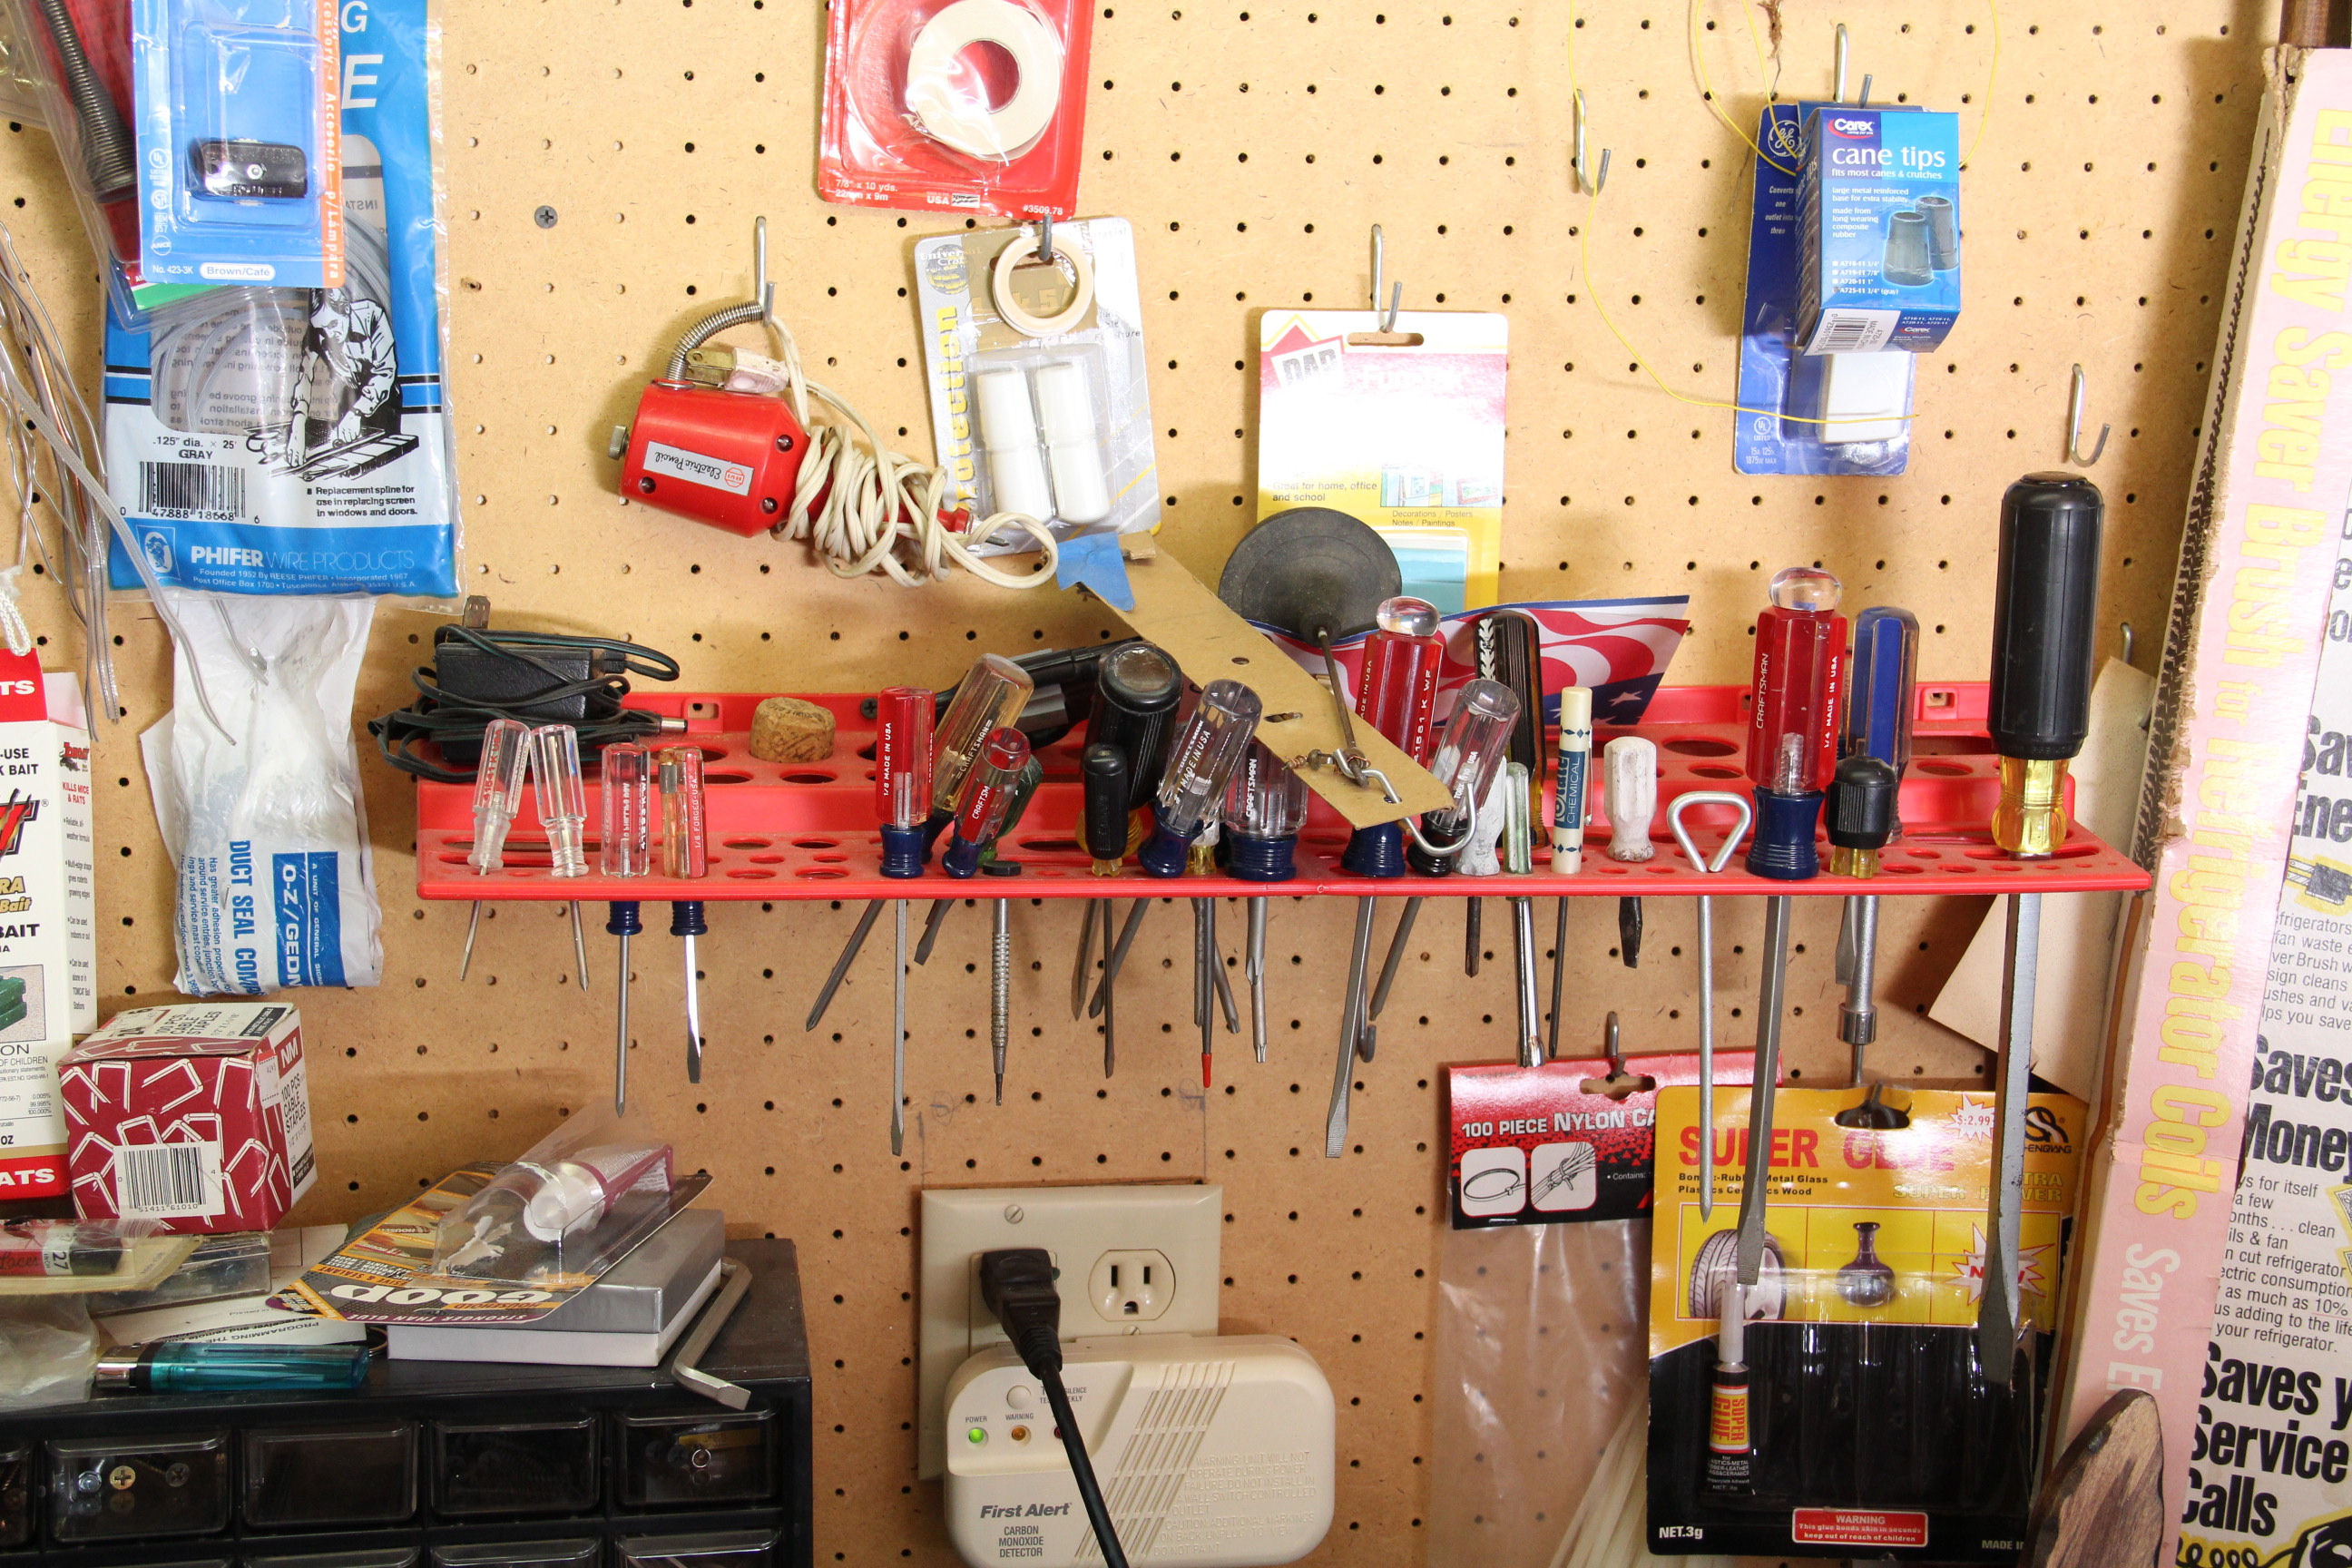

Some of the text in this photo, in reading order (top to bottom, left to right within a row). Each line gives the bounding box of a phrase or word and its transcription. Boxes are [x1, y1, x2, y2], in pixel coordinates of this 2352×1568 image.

[324, 92, 336, 172] Accesorio
[1834, 118, 1873, 132] Carex
[1832, 146, 1946, 171] cane tips
[1831, 168, 1846, 177] fits
[1871, 170, 1896, 178] canes
[1906, 171, 1942, 180] crutches
[878, 183, 898, 193] yds.
[1769, 185, 1794, 195] Converts
[1832, 187, 1849, 195] large
[1873, 187, 1909, 196] reinforced
[926, 195, 950, 206] USA
[1023, 205, 1063, 216] #3509.78
[1832, 215, 1879, 225] long wearing
[1832, 224, 1869, 232] composite
[207, 266, 270, 277] Brown/Café
[2253, 325, 2352, 494] Saver
[183, 437, 203, 447] dia.
[178, 449, 213, 460] GRAY
[654, 452, 722, 481] Electric Pencil
[316, 485, 401, 497] Replacement spline
[1317, 481, 1377, 493] home, office
[344, 497, 416, 507] replacing screen
[1272, 493, 1326, 502] and school
[327, 507, 418, 516] windows and doors.
[1392, 510, 1475, 518] Decorations Posters
[1392, 518, 1455, 529] Notes Paintings
[191, 545, 416, 572] PHIFER WIRE PRODUCTS
[193, 576, 238, 586] Post Office
[200, 568, 236, 578] Founded
[2223, 503, 2328, 670] Brush
[1365, 659, 1373, 683] USA
[1756, 652, 1769, 730] CRAFTSMAN
[1826, 655, 1838, 727] MADE USA
[959, 725, 991, 773] CRAFTSMAN
[1180, 729, 1211, 789] MADE USA
[9, 764, 39, 776] BAIT
[62, 781, 77, 793] KILLS
[1246, 759, 1258, 818] CRAFTSMAN
[1566, 757, 1581, 824] CHEMICAL
[198, 858, 209, 918] around service
[230, 840, 256, 940] DUCT SEAL
[190, 893, 199, 923] service
[209, 874, 221, 945] greater adhesion
[2301, 935, 2344, 955] waste
[2296, 952, 2339, 974] Brush
[2302, 973, 2348, 993] cleans
[2309, 993, 2337, 1011] and
[2288, 1009, 2315, 1027] you
[280, 1036, 299, 1069] NM
[9, 1055, 49, 1067] CHILDREN
[283, 1092, 301, 1118] CABLE
[286, 1102, 307, 1134] STAPLES
[1461, 1110, 1625, 1138] 100 PIECE NYLON
[2134, 1083, 2231, 1221] Coils
[1612, 1171, 1647, 1181] Contains:
[1797, 1174, 1829, 1184] Glass
[1781, 1186, 1813, 1196] Wood
[1893, 1184, 1966, 1200] SUPER
[2259, 1175, 2318, 1198] for itself
[138, 1202, 199, 1213] 51411 61010
[2248, 1192, 2274, 1210] few
[2298, 1220, 2336, 1239] clean
[2267, 1234, 2288, 1250] fan
[53, 1251, 71, 1270] 27
[2239, 1250, 2347, 1279] cut refrigerator
[318, 1266, 366, 1279] SEALANT
[2260, 1272, 2352, 1298] consumption
[329, 1284, 554, 1305] GOOP
[2113, 1243, 2181, 1355] Saves
[2225, 1287, 2349, 1318] as much as 10%
[453, 1302, 542, 1311] HOUSEHOLD
[347, 1313, 528, 1323] STRONGER THAN GLUE
[2235, 1306, 2330, 1333] adding to the
[230, 1321, 319, 1341] PROGRAMMING
[2215, 1321, 2338, 1353] your refrigerator.
[2200, 1340, 2322, 1417] Saves
[965, 1415, 988, 1424] POWER
[1005, 1412, 1034, 1421] WARNING
[1712, 1396, 1731, 1441] GLUE
[1730, 1397, 1746, 1441] SUPER
[2191, 1403, 2350, 1485] Service
[1190, 1463, 1307, 1479] OPERATE DURING POWER
[1264, 1475, 1303, 1487] INSTALL
[1249, 1487, 1316, 1500] CONTROLLED
[2180, 1466, 2278, 1538] Calls
[980, 1502, 1070, 1519] First Alert
[1267, 1511, 1315, 1524] MARKINGS
[1836, 1514, 1886, 1525] WARNING
[1004, 1524, 1040, 1536] CARBON
[1657, 1525, 1704, 1541] NET.3g
[1798, 1523, 1816, 1531] This
[1818, 1524, 1834, 1533] glue
[998, 1535, 1044, 1547] MONOXIDE
[1804, 1532, 1823, 1541] keep
[1883, 1534, 1916, 1542] children
[999, 1546, 1044, 1559] DETECTOR
